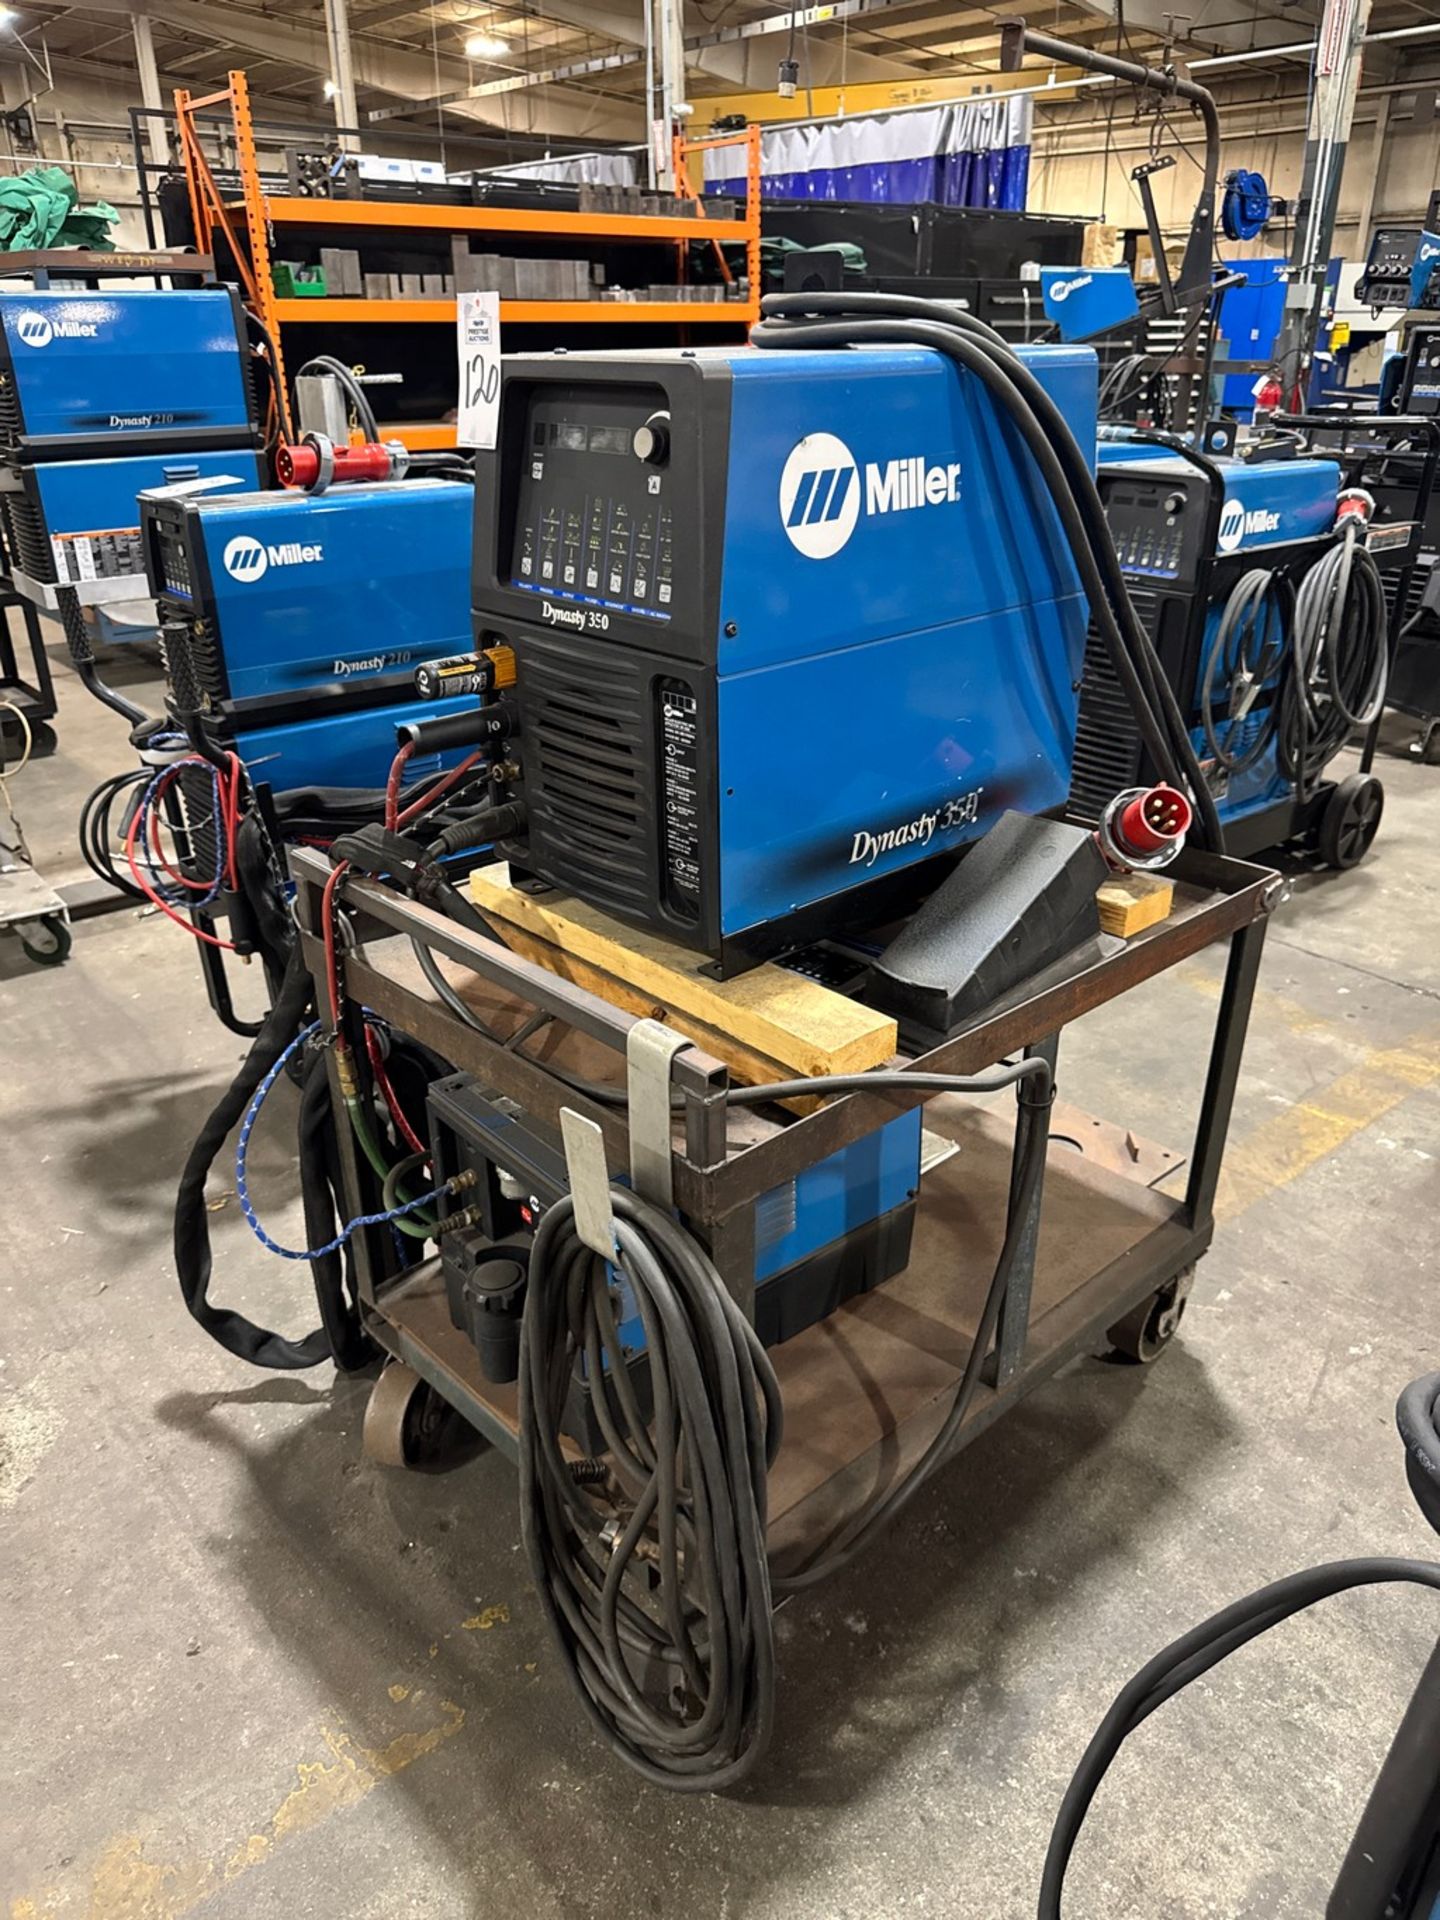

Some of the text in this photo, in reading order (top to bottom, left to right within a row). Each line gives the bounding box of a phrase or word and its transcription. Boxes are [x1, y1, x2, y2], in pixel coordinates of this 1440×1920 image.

[53, 321, 98, 337] Miller
[465, 354, 499, 409] 120
[109, 414, 174, 428] Dynasty 210
[866, 456, 961, 516] Miller
[1245, 509, 1280, 535] Miller
[267, 543, 324, 567] Miller
[542, 601, 588, 631] Dynasty
[588, 611, 610, 631] 350
[333, 651, 411, 678] Dynasty 210
[848, 789, 981, 868] Dynasty 350
